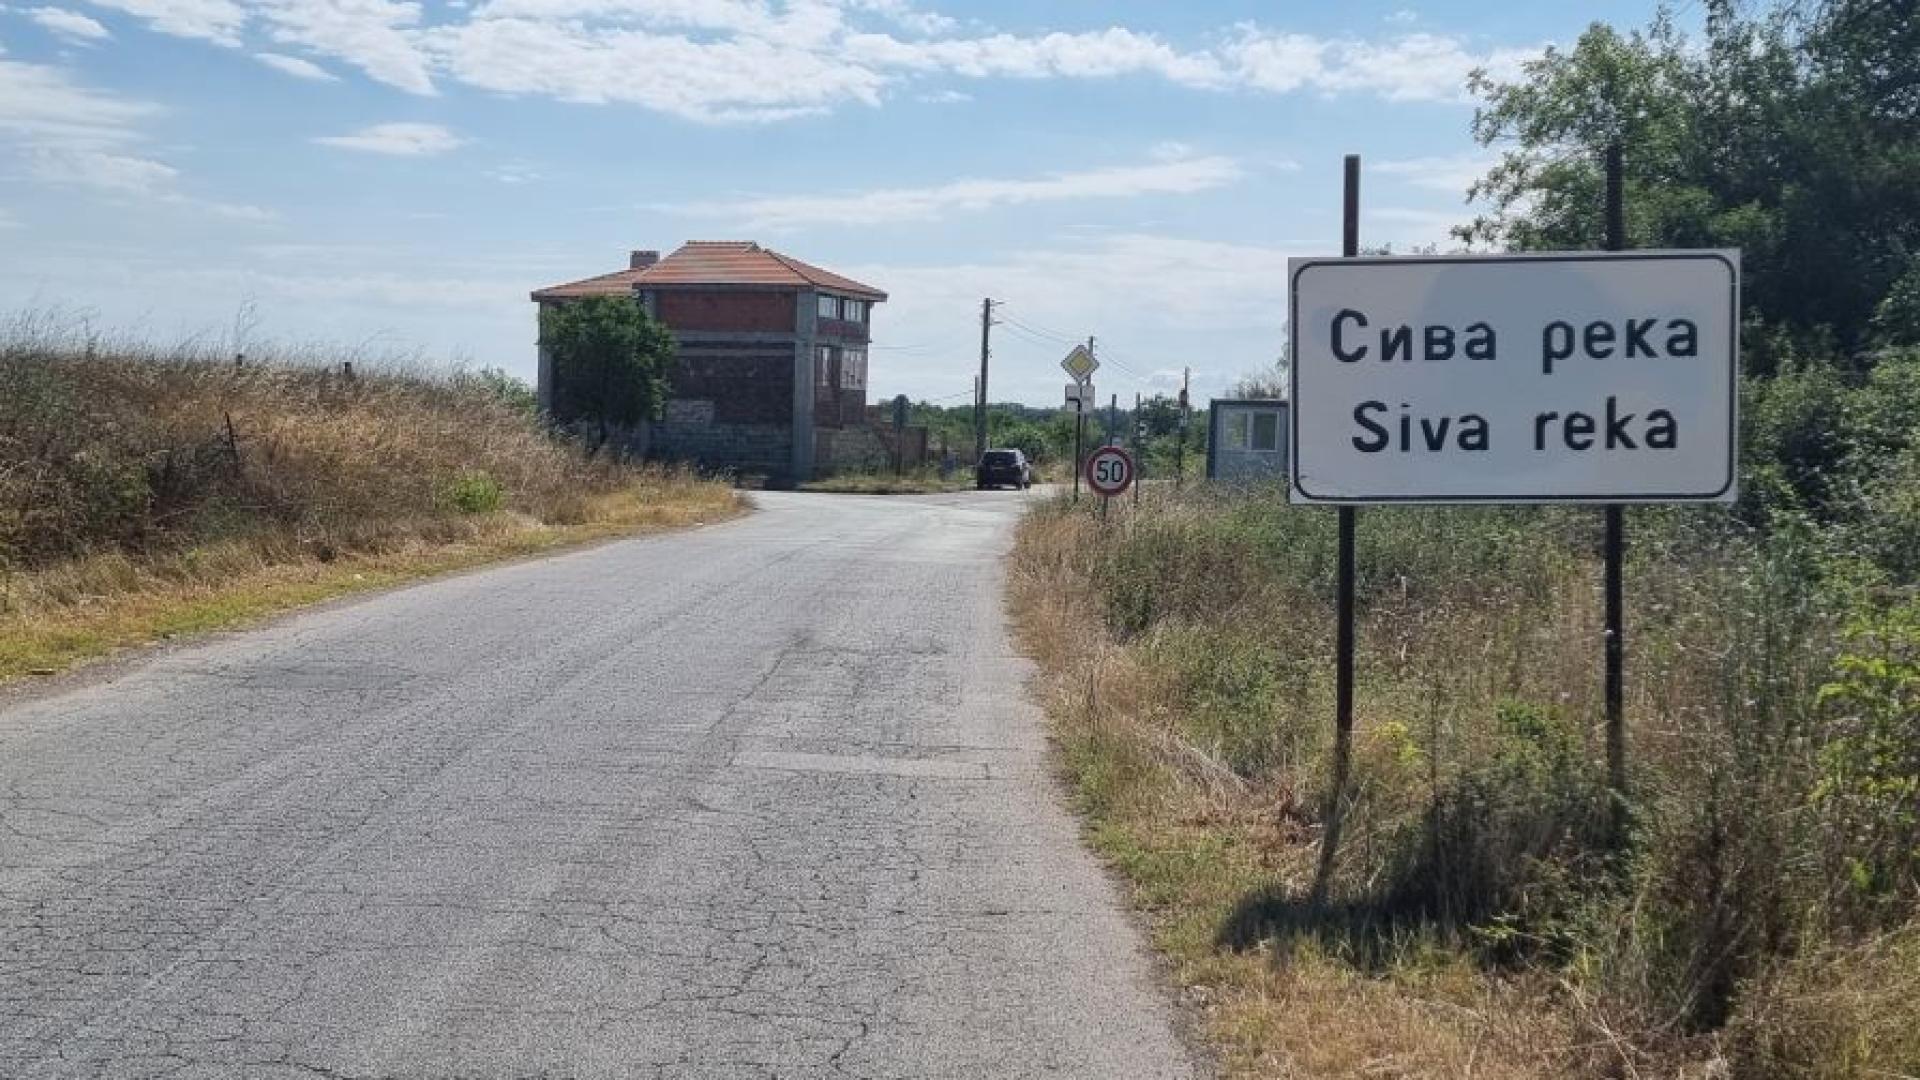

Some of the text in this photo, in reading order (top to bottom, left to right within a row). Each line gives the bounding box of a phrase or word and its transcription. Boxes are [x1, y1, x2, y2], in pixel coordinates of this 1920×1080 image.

[1330, 308, 1698, 375] Сива река
[1351, 396, 1677, 452] Siva reka
[1096, 460, 1124, 483] 50
